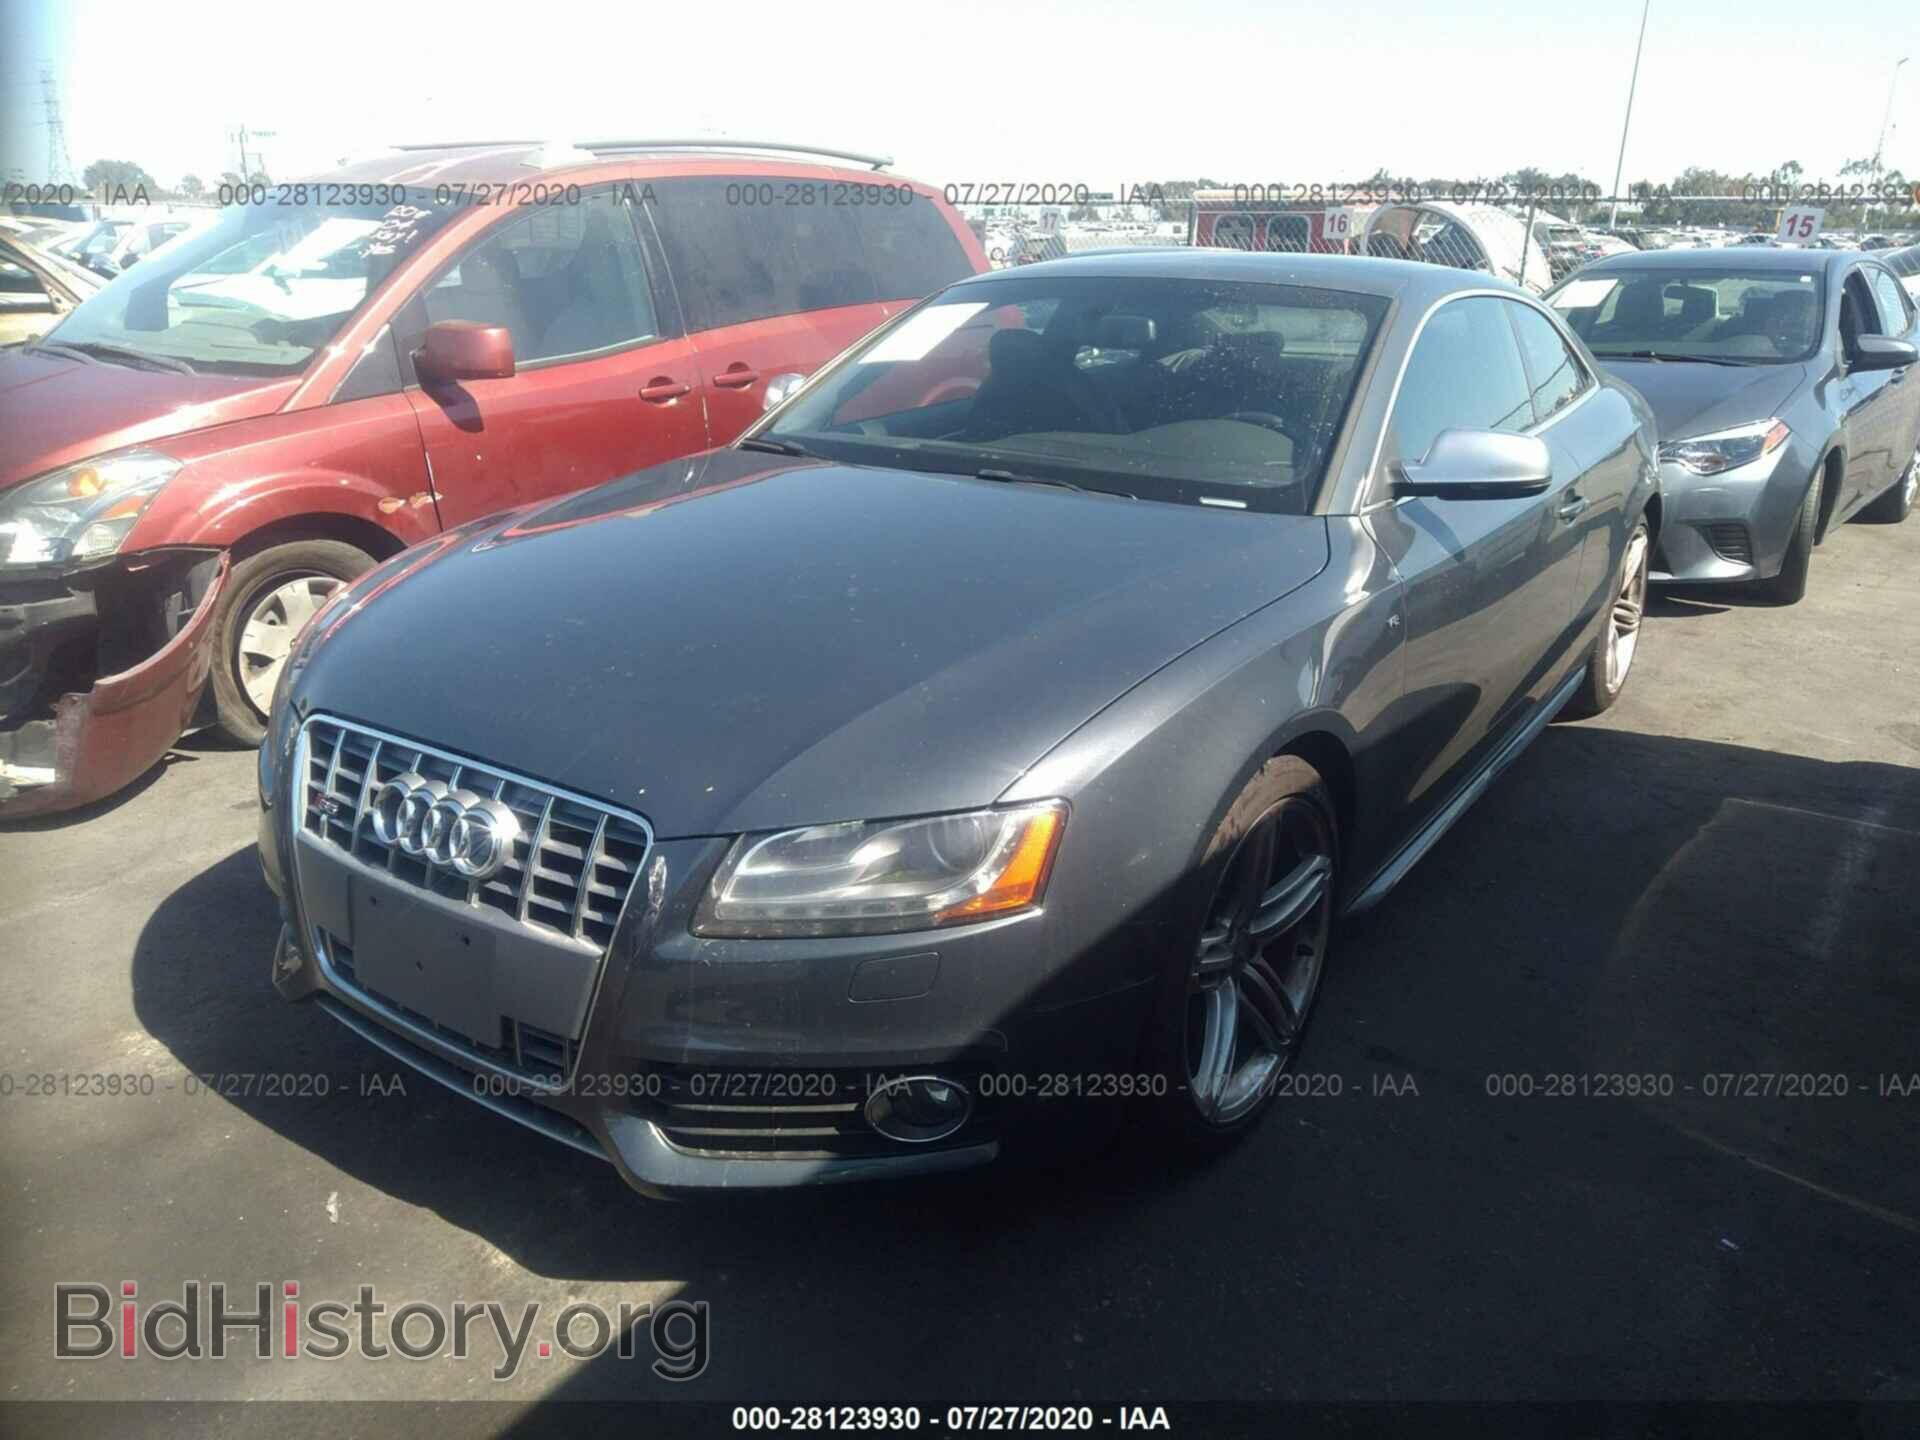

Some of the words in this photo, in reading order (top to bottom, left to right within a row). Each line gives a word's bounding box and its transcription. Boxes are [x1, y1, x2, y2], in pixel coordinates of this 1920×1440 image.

[1041, 211, 1058, 229] 17
[1328, 214, 1348, 233] 16
[1786, 213, 1815, 238] 15
